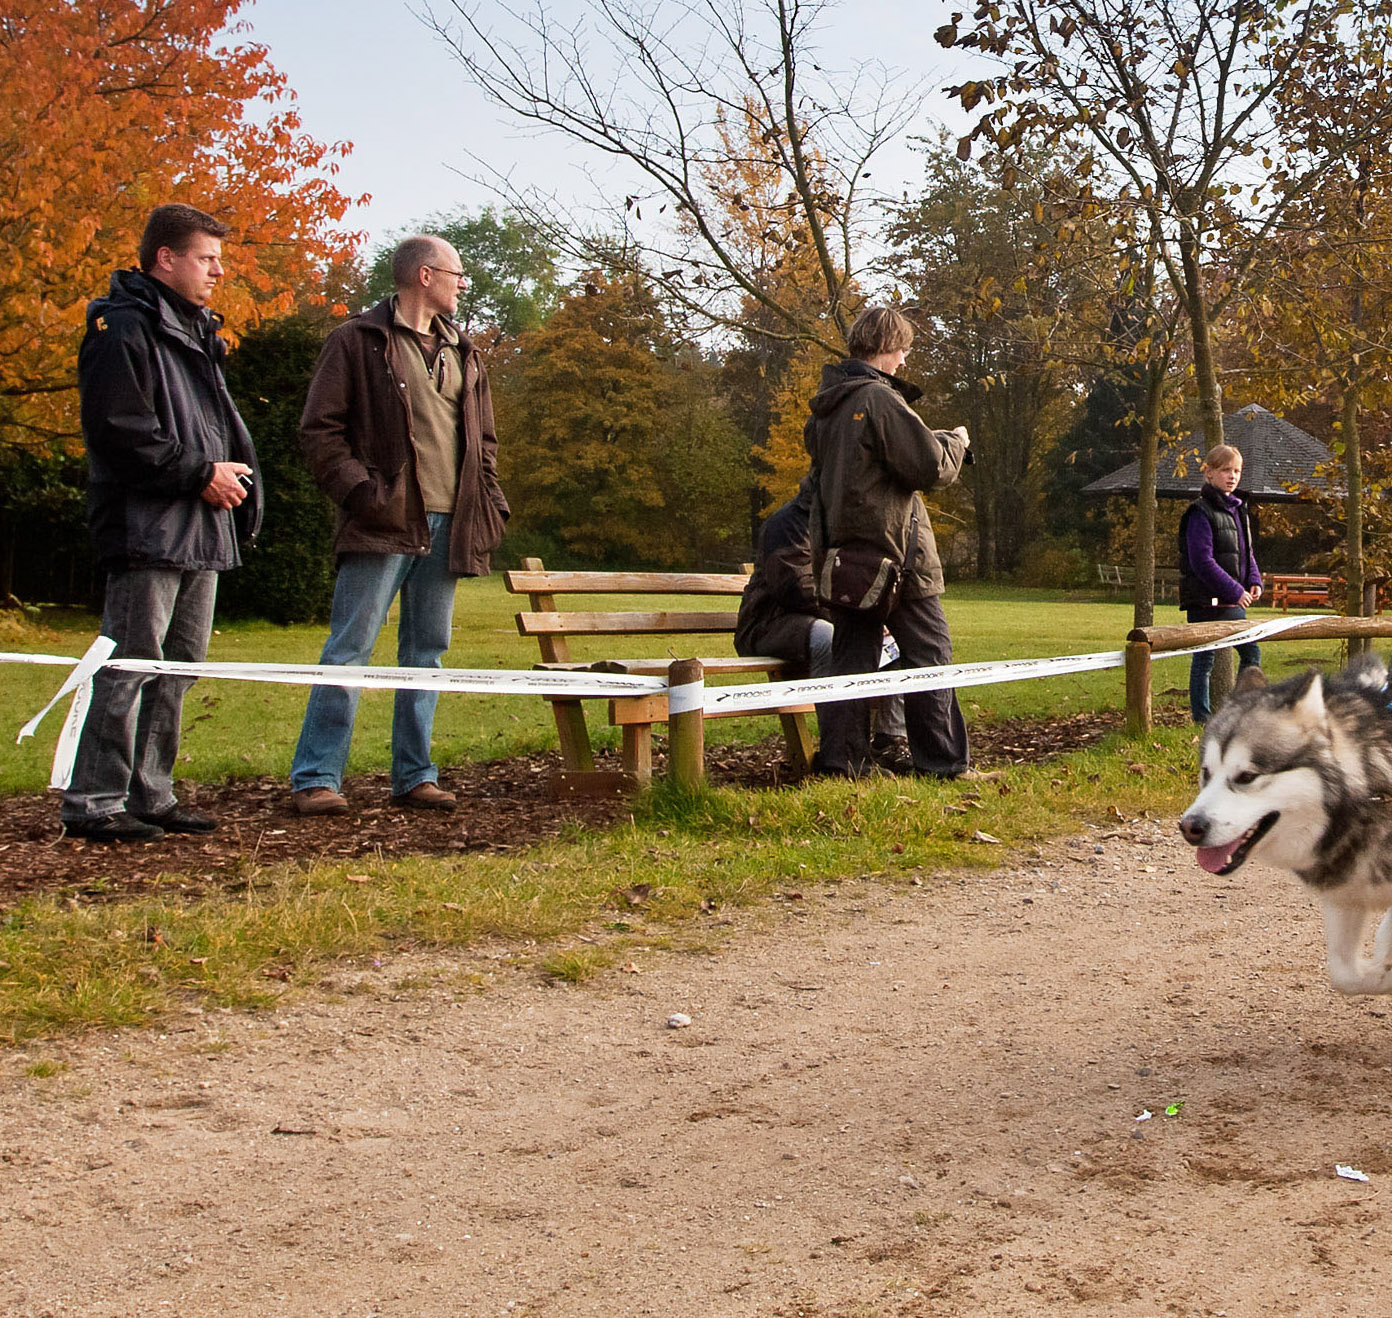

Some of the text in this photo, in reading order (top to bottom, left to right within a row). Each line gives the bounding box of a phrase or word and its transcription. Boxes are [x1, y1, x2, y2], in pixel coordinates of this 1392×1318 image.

[856, 677, 892, 687] BROOKS
[797, 683, 834, 693] BROOKS
[732, 689, 772, 699] BROOKS
